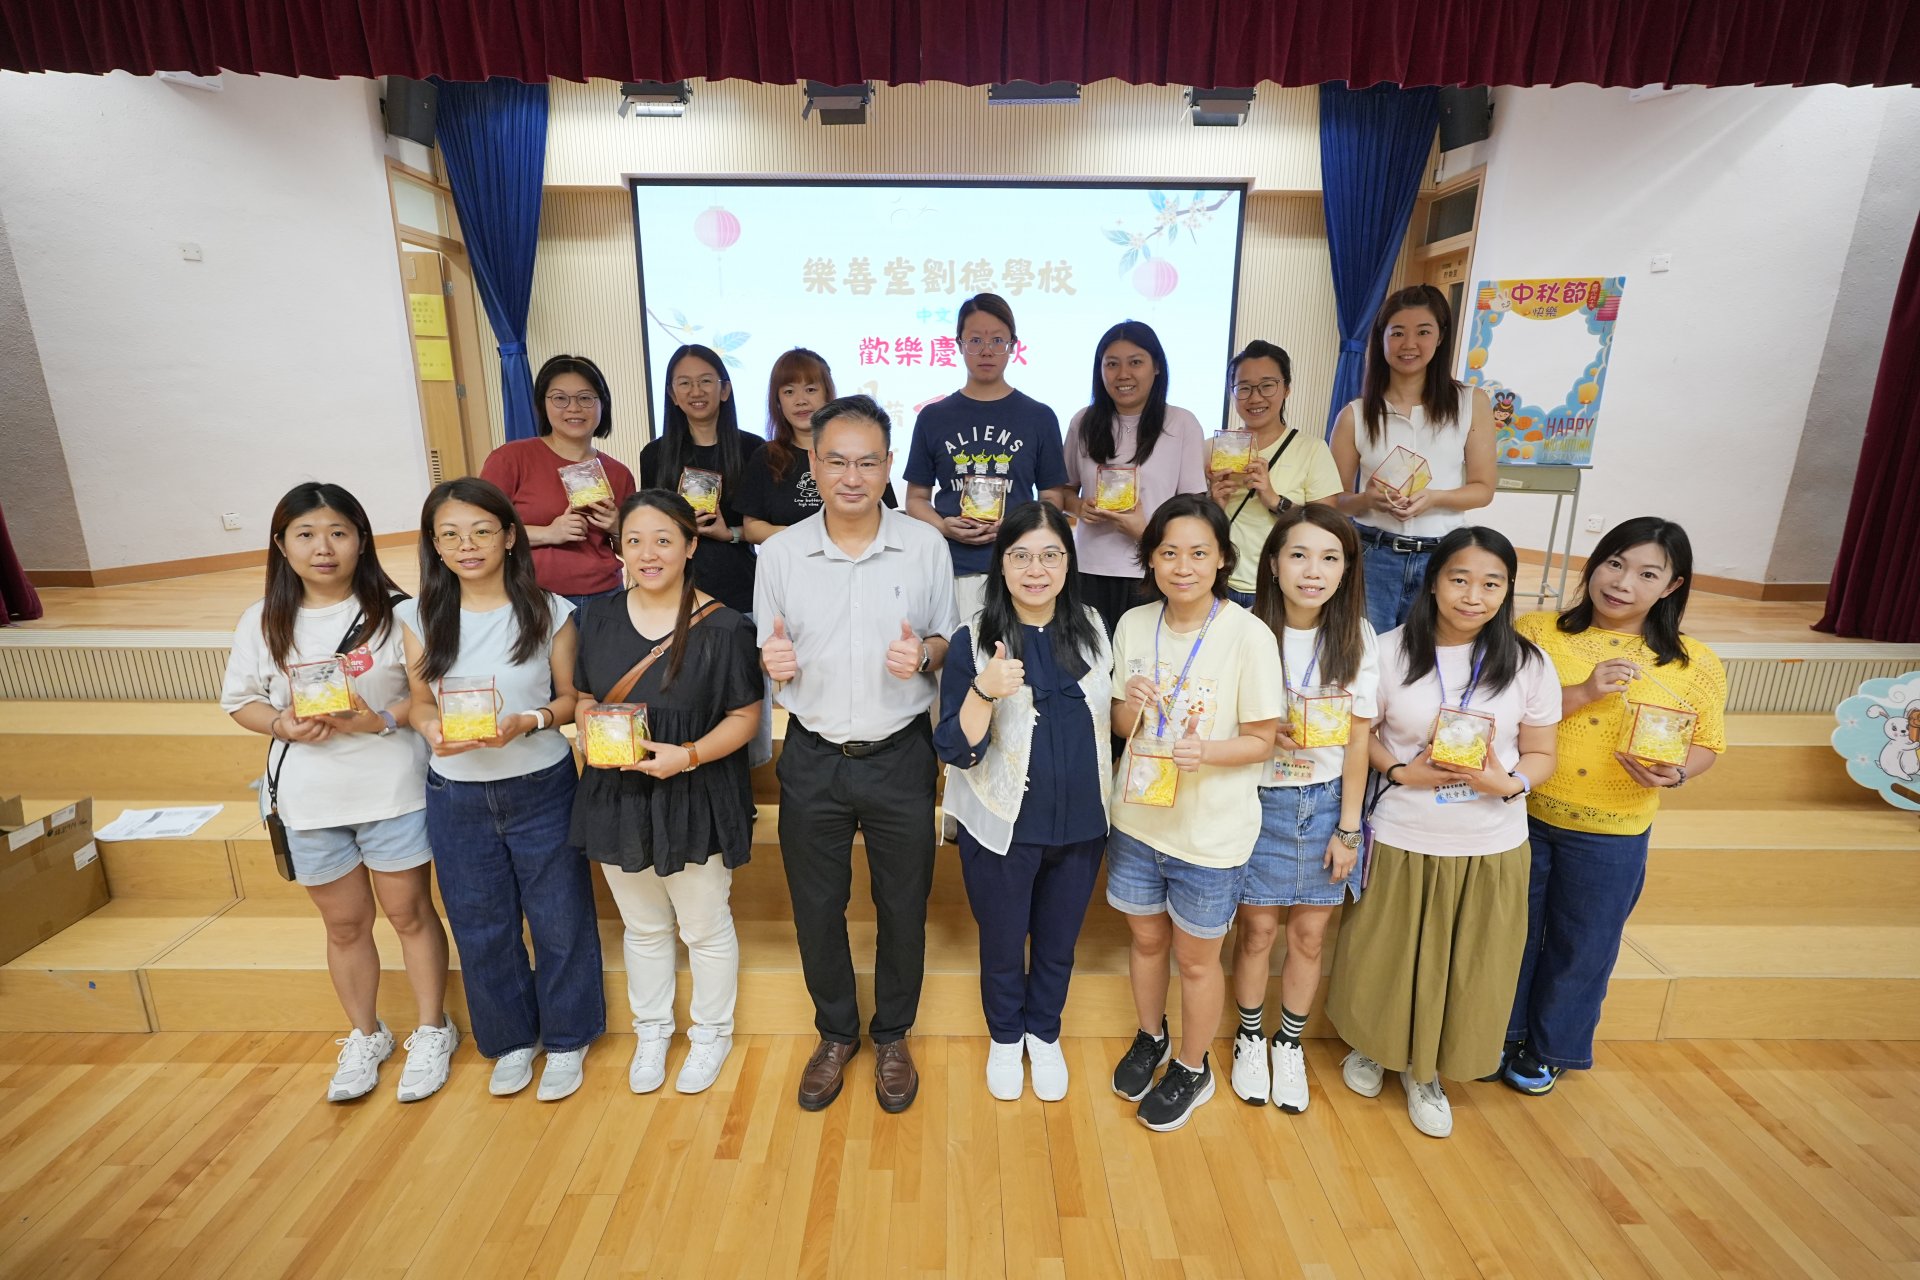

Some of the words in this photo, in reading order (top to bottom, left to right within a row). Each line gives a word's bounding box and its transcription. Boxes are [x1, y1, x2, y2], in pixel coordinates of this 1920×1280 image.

[803, 256, 1077, 296] 樂善堂劉德學校
[1511, 281, 1587, 305] 中秋節
[915, 307, 958, 325] 中文
[1532, 305, 1558, 318] 快樂
[859, 335, 1028, 368] 歡樂慶
[1545, 417, 1595, 437] HAPPY
[944, 425, 1024, 454] ALIENS
